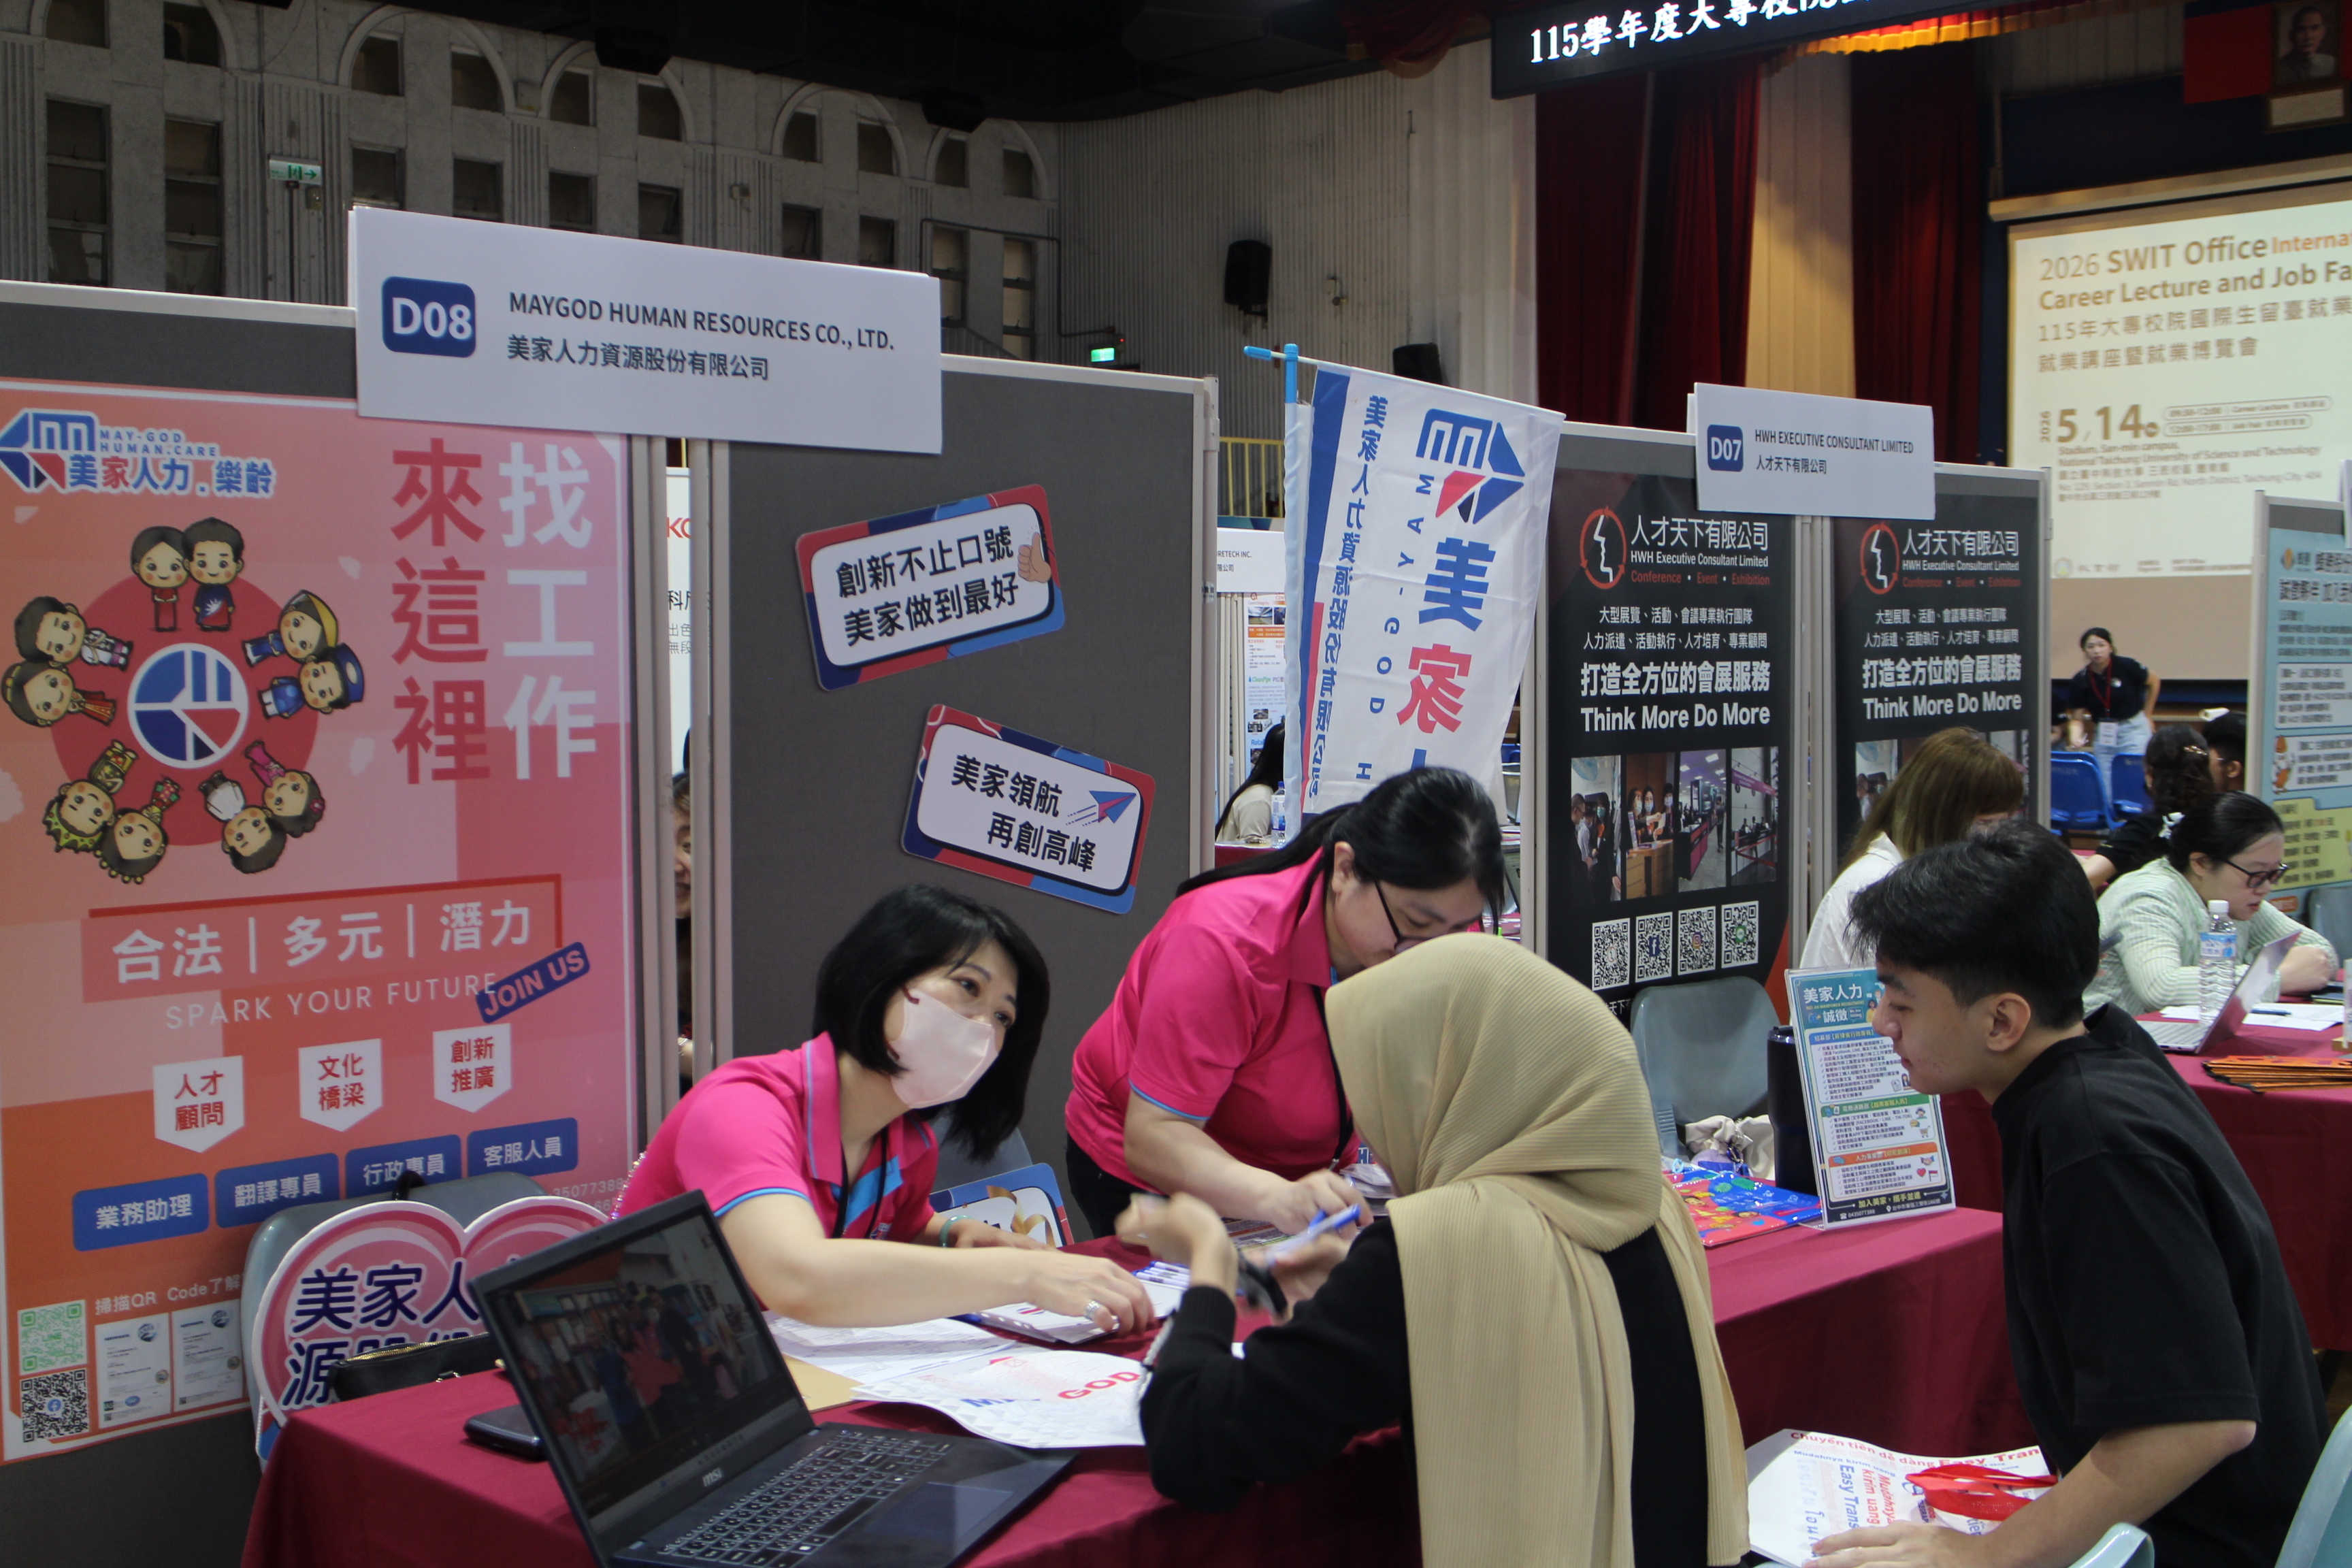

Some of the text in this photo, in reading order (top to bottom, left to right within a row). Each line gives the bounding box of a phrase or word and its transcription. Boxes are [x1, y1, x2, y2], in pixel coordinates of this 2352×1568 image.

[1531, 0, 1872, 63] 115學年度大專校
[2040, 235, 2352, 282] 2026 SWIT Office Interna
[2040, 288, 2114, 310] Career
[2121, 278, 2210, 304] Lecture
[2217, 267, 2264, 293] and
[2270, 263, 2317, 288] Job
[392, 297, 472, 340] D08
[509, 292, 894, 350] MAYGOD HUMAN RESOURCES CO., LTD.
[507, 334, 769, 380] 美家人力資源股份有限公司
[99, 429, 182, 444] MAY-GOD
[99, 442, 217, 457] HUMAN.CARE
[1710, 438, 1742, 461] D07
[1754, 429, 1914, 454] HWH EXECUTIVE CONSULTANT LIMITED
[1756, 454, 1827, 474] 人才天下有限公司
[1631, 514, 1768, 551] 人才天下有限公司
[1903, 528, 2019, 556] 人才天下有限公司
[836, 526, 1014, 599] 創新不止口號
[1631, 551, 1769, 568] HWH Executive Consultant Limited
[1902, 560, 2020, 571] HWH Executive Consultant Limited
[1631, 570, 1770, 585] Conference Event Exhibition
[390, 438, 490, 785] 來這裡
[499, 442, 597, 780] 找工作
[844, 572, 1019, 647] 美家做到最好
[1581, 660, 1770, 697] 打造全方位的會展服務
[1862, 653, 2022, 689] 打造全方位的會展服務
[1581, 702, 1770, 732] Think More Do More
[1863, 691, 2022, 719] Think More Do More
[951, 754, 1063, 818] 美家領航
[987, 811, 1096, 872] 再創高峰
[112, 899, 531, 983] 合法 多元 潛力
[484, 949, 585, 1018] JOIN US
[1803, 983, 1863, 1004] 美家人力
[165, 973, 496, 1030] SPARK YOUR FUTURE
[1823, 1009, 1848, 1023] 誠徵
[450, 1036, 495, 1064] 創新
[317, 1052, 365, 1082] 文化
[451, 1066, 495, 1093] 推廣
[175, 1070, 225, 1100] 人才
[318, 1081, 365, 1111] 橋梁
[175, 1100, 225, 1132] 顧問
[483, 1136, 563, 1168] 客服人員
[363, 1153, 445, 1186] 行政專員
[234, 1173, 324, 1209] 翻譯專員
[95, 1194, 193, 1230] 業務助理
[95, 1291, 158, 1316] 掃描QR
[1057, 1371, 1141, 1399] GOD
[1794, 1450, 1844, 1462] Mudahnya
[1839, 1465, 1855, 1494] Easy
[1862, 1469, 1880, 1524] kirim uang
